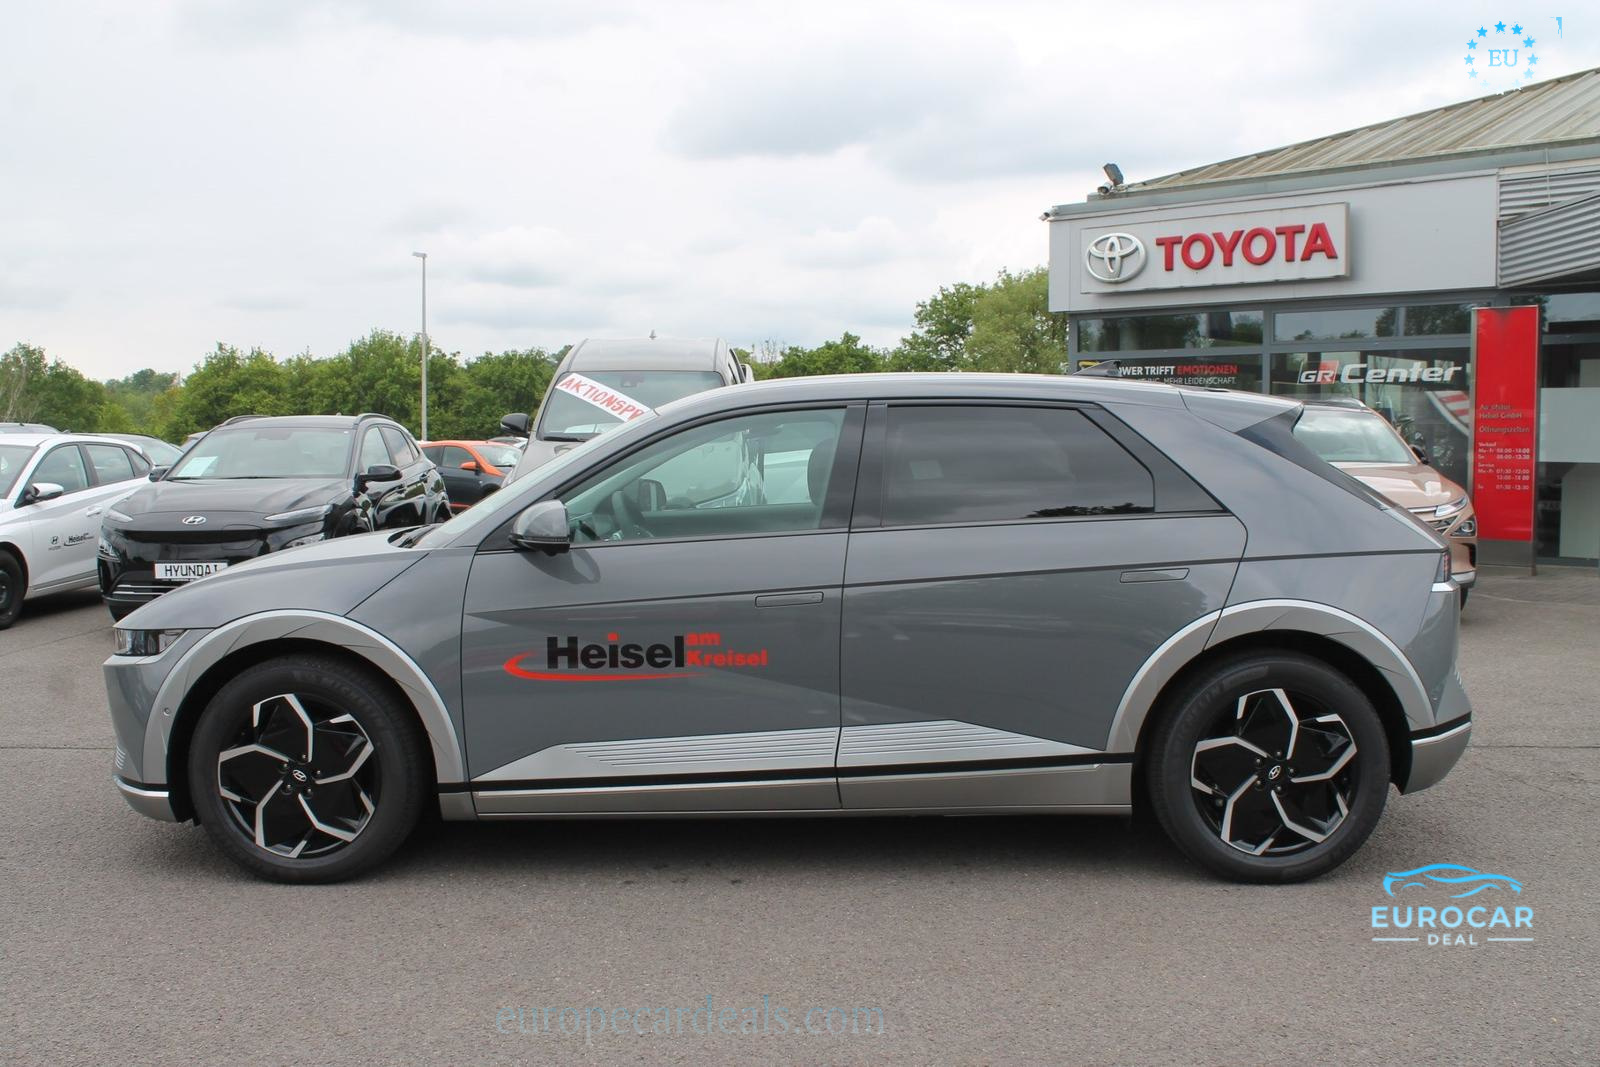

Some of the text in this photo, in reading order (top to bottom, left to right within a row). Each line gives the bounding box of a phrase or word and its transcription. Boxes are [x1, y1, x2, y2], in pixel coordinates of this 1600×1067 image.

[1156, 222, 1338, 271] TOYOTA
[1144, 365, 1176, 375] TRIFFT
[1177, 364, 1238, 375] EMOTIONEN
[1301, 361, 1463, 384] GR Center
[547, 632, 721, 669] Heisel am
[687, 649, 768, 667] Kreisel
